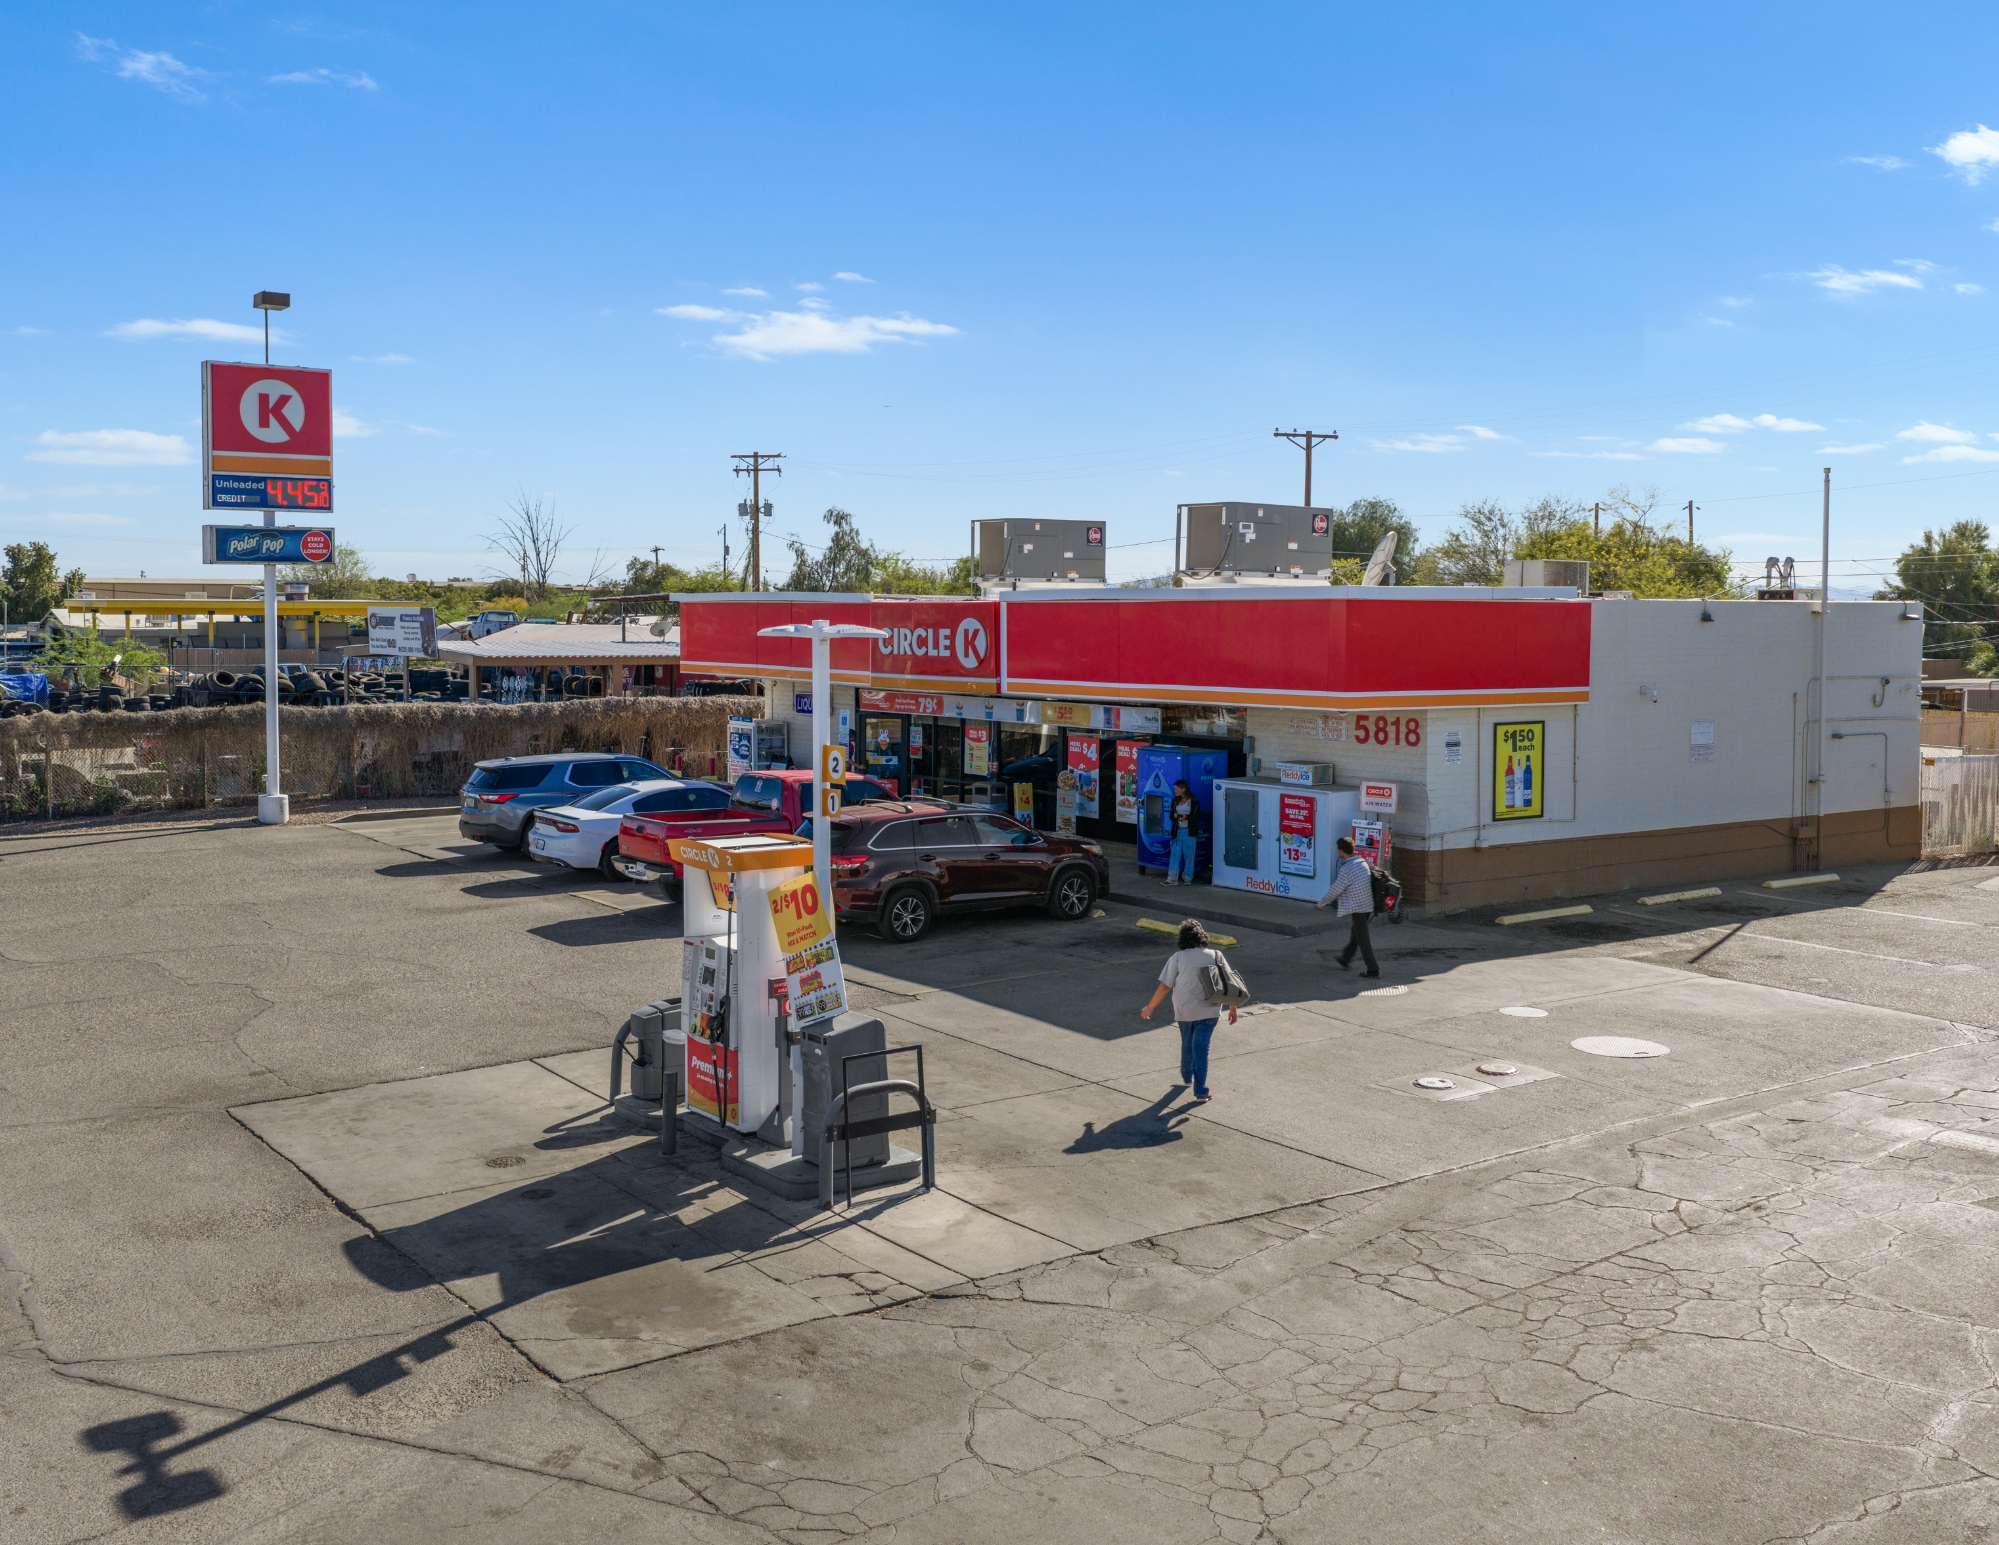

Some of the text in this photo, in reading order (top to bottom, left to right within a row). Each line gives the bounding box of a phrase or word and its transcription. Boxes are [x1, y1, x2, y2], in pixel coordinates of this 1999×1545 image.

[258, 392, 302, 442] K
[215, 479, 265, 490] Unleaded
[267, 479, 319, 507] 4.45
[217, 494, 247, 503] CREDIT
[229, 534, 285, 554] Polar Pop
[878, 627, 952, 657] CIRCLE
[918, 697, 938, 713] 79¢
[978, 730, 987, 741] $3
[1354, 714, 1421, 747] 5818
[1082, 743, 1098, 761] $4
[1518, 743, 1535, 752] each
[832, 756, 839, 773] 2
[830, 794, 835, 811] 1
[680, 846, 708, 863] CIRCLE
[726, 854, 732, 867] 2
[1246, 876, 1290, 894] ReddyIce
[772, 883, 819, 921] 2/$10
[788, 940, 796, 948] MIX
[799, 930, 817, 943] MATCH
